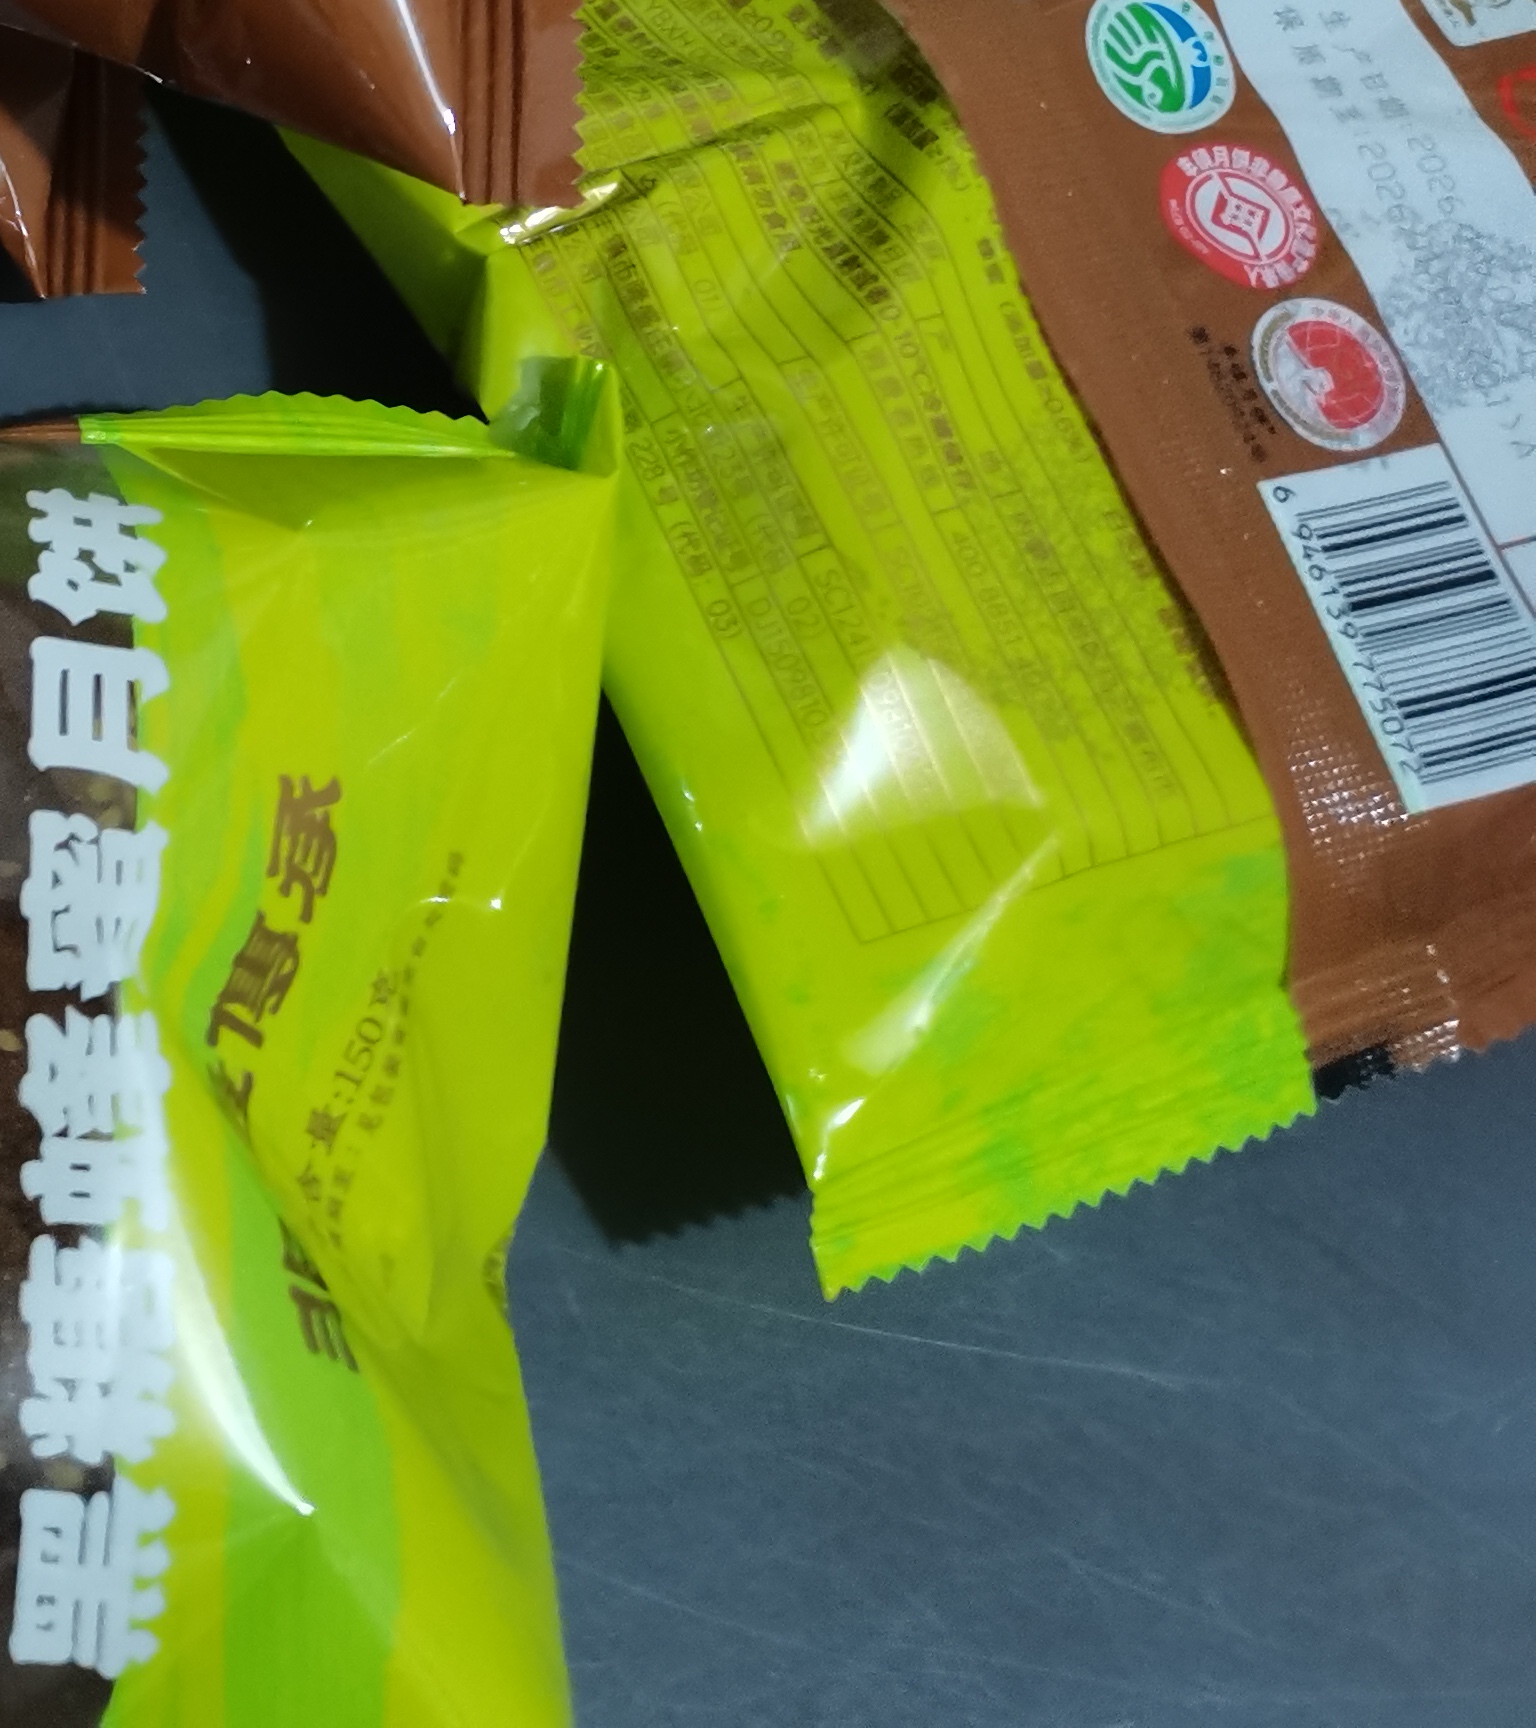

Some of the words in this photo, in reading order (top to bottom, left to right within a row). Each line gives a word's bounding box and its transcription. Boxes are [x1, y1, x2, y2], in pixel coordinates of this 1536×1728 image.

[1273, 485, 1296, 504] 6
[1297, 520, 1359, 642] 946139
[1353, 654, 1417, 775] 775072
[8, 488, 178, 1680] 黑糖蜂蜜月饼
